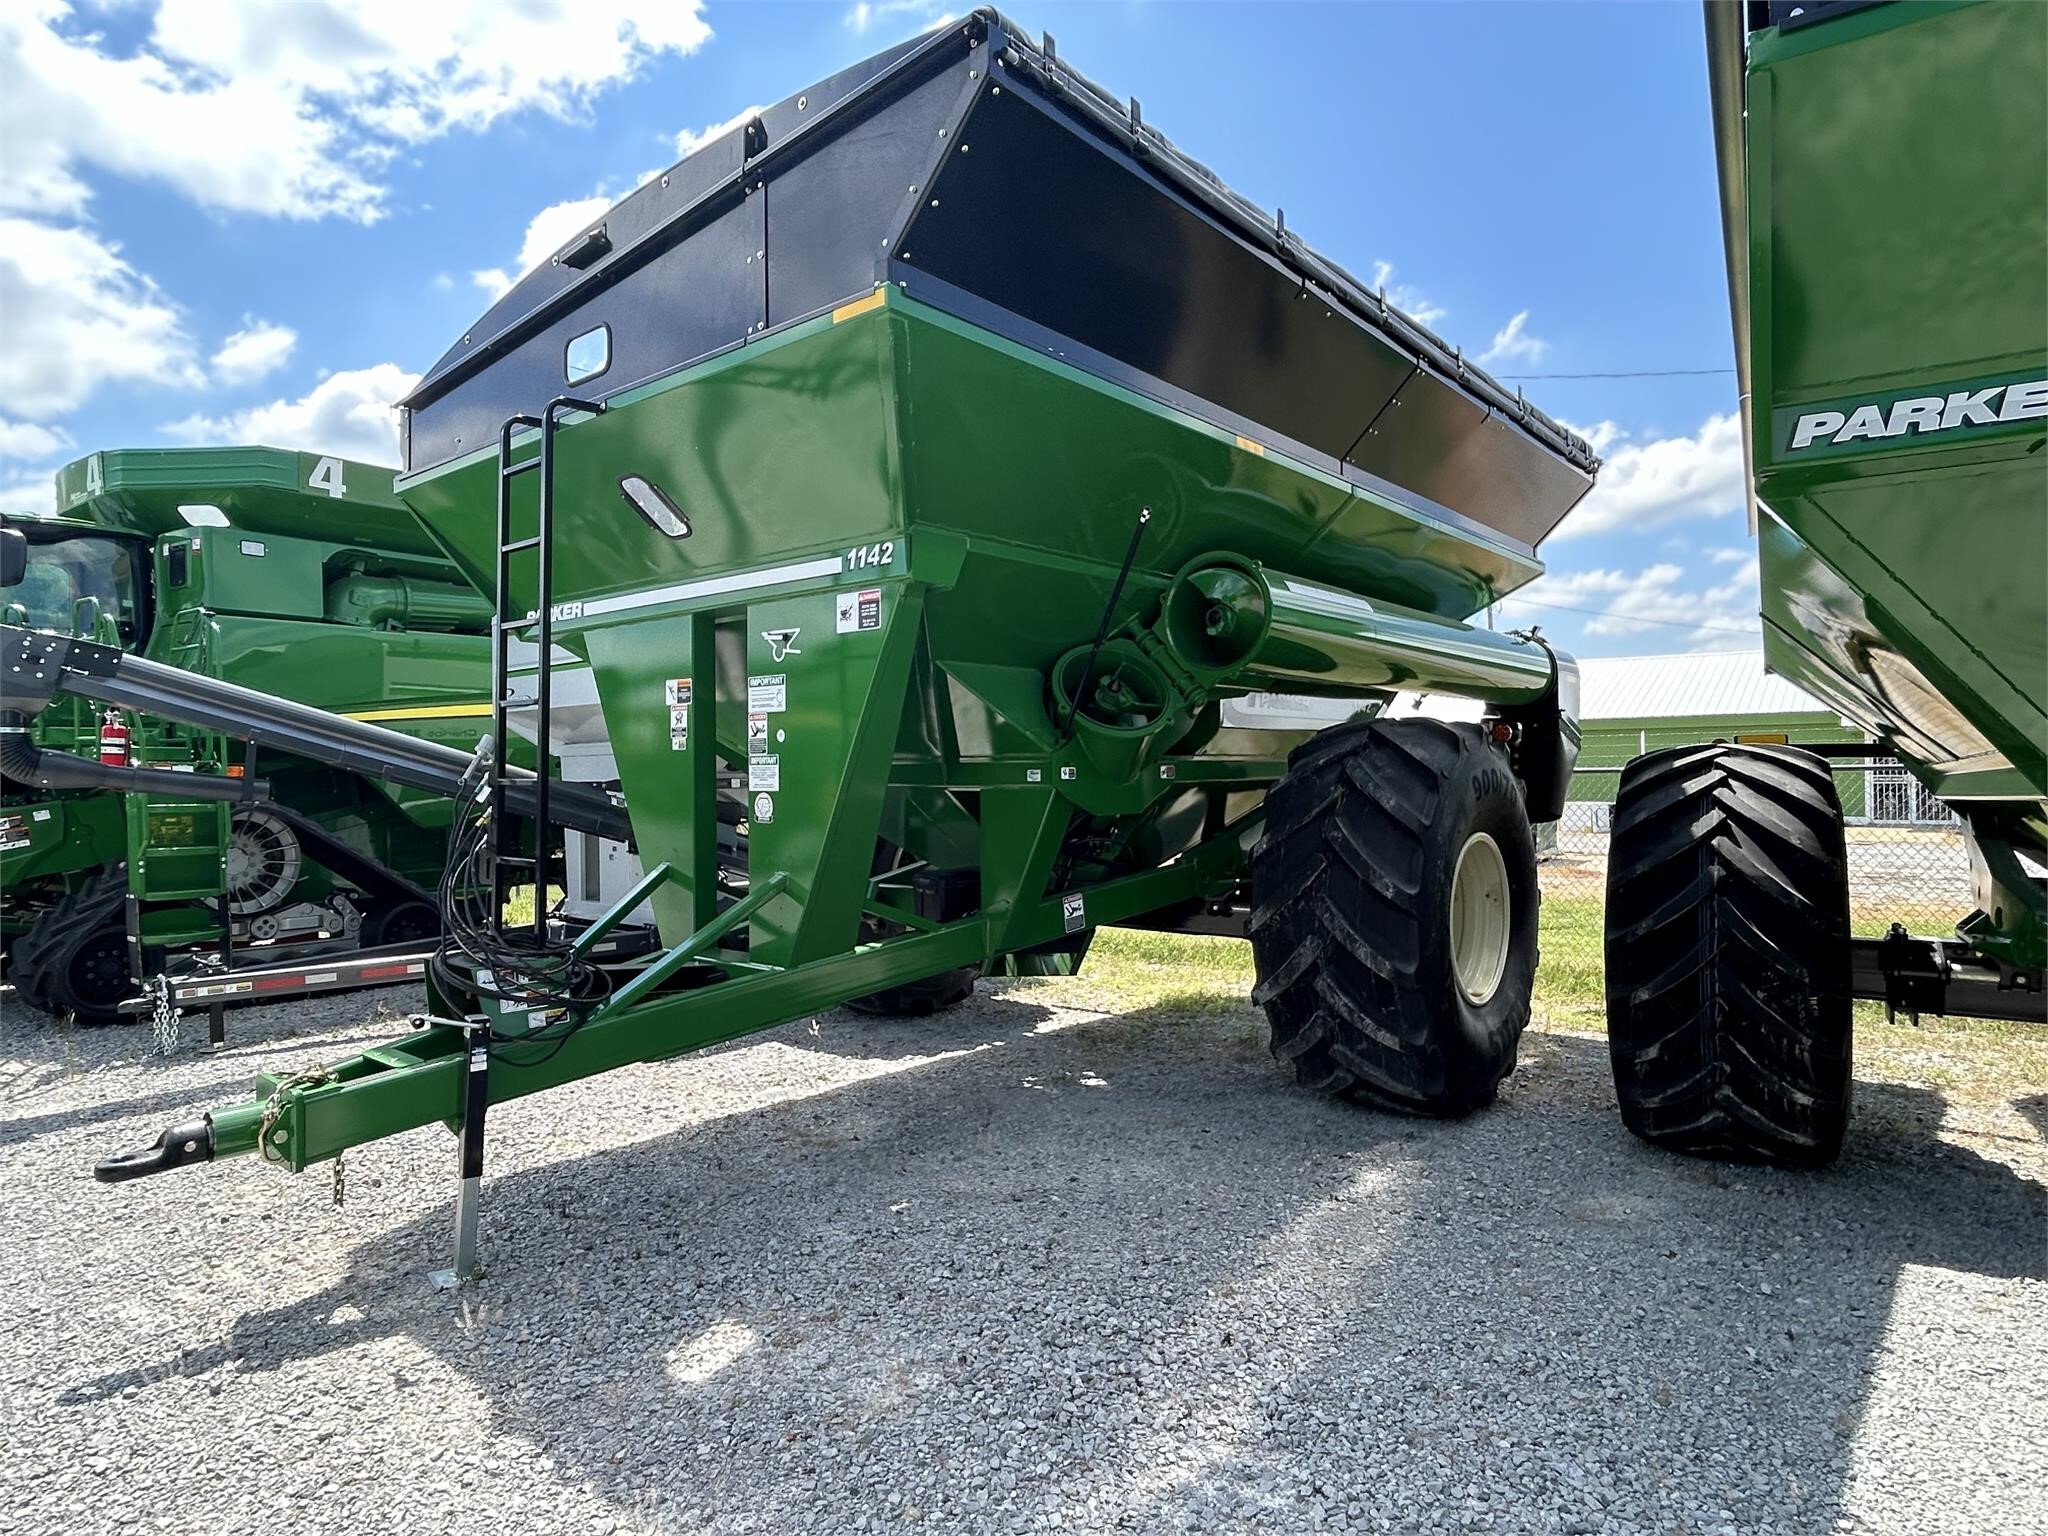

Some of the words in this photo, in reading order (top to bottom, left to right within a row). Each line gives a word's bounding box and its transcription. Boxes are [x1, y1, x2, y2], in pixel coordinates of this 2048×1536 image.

[87, 454, 101, 496] 4
[309, 456, 347, 499] 4
[847, 541, 894, 570] 1142
[526, 602, 582, 621] PKER
[750, 676, 783, 687] IMPORTANT
[750, 756, 777, 765] IMPORTANT
